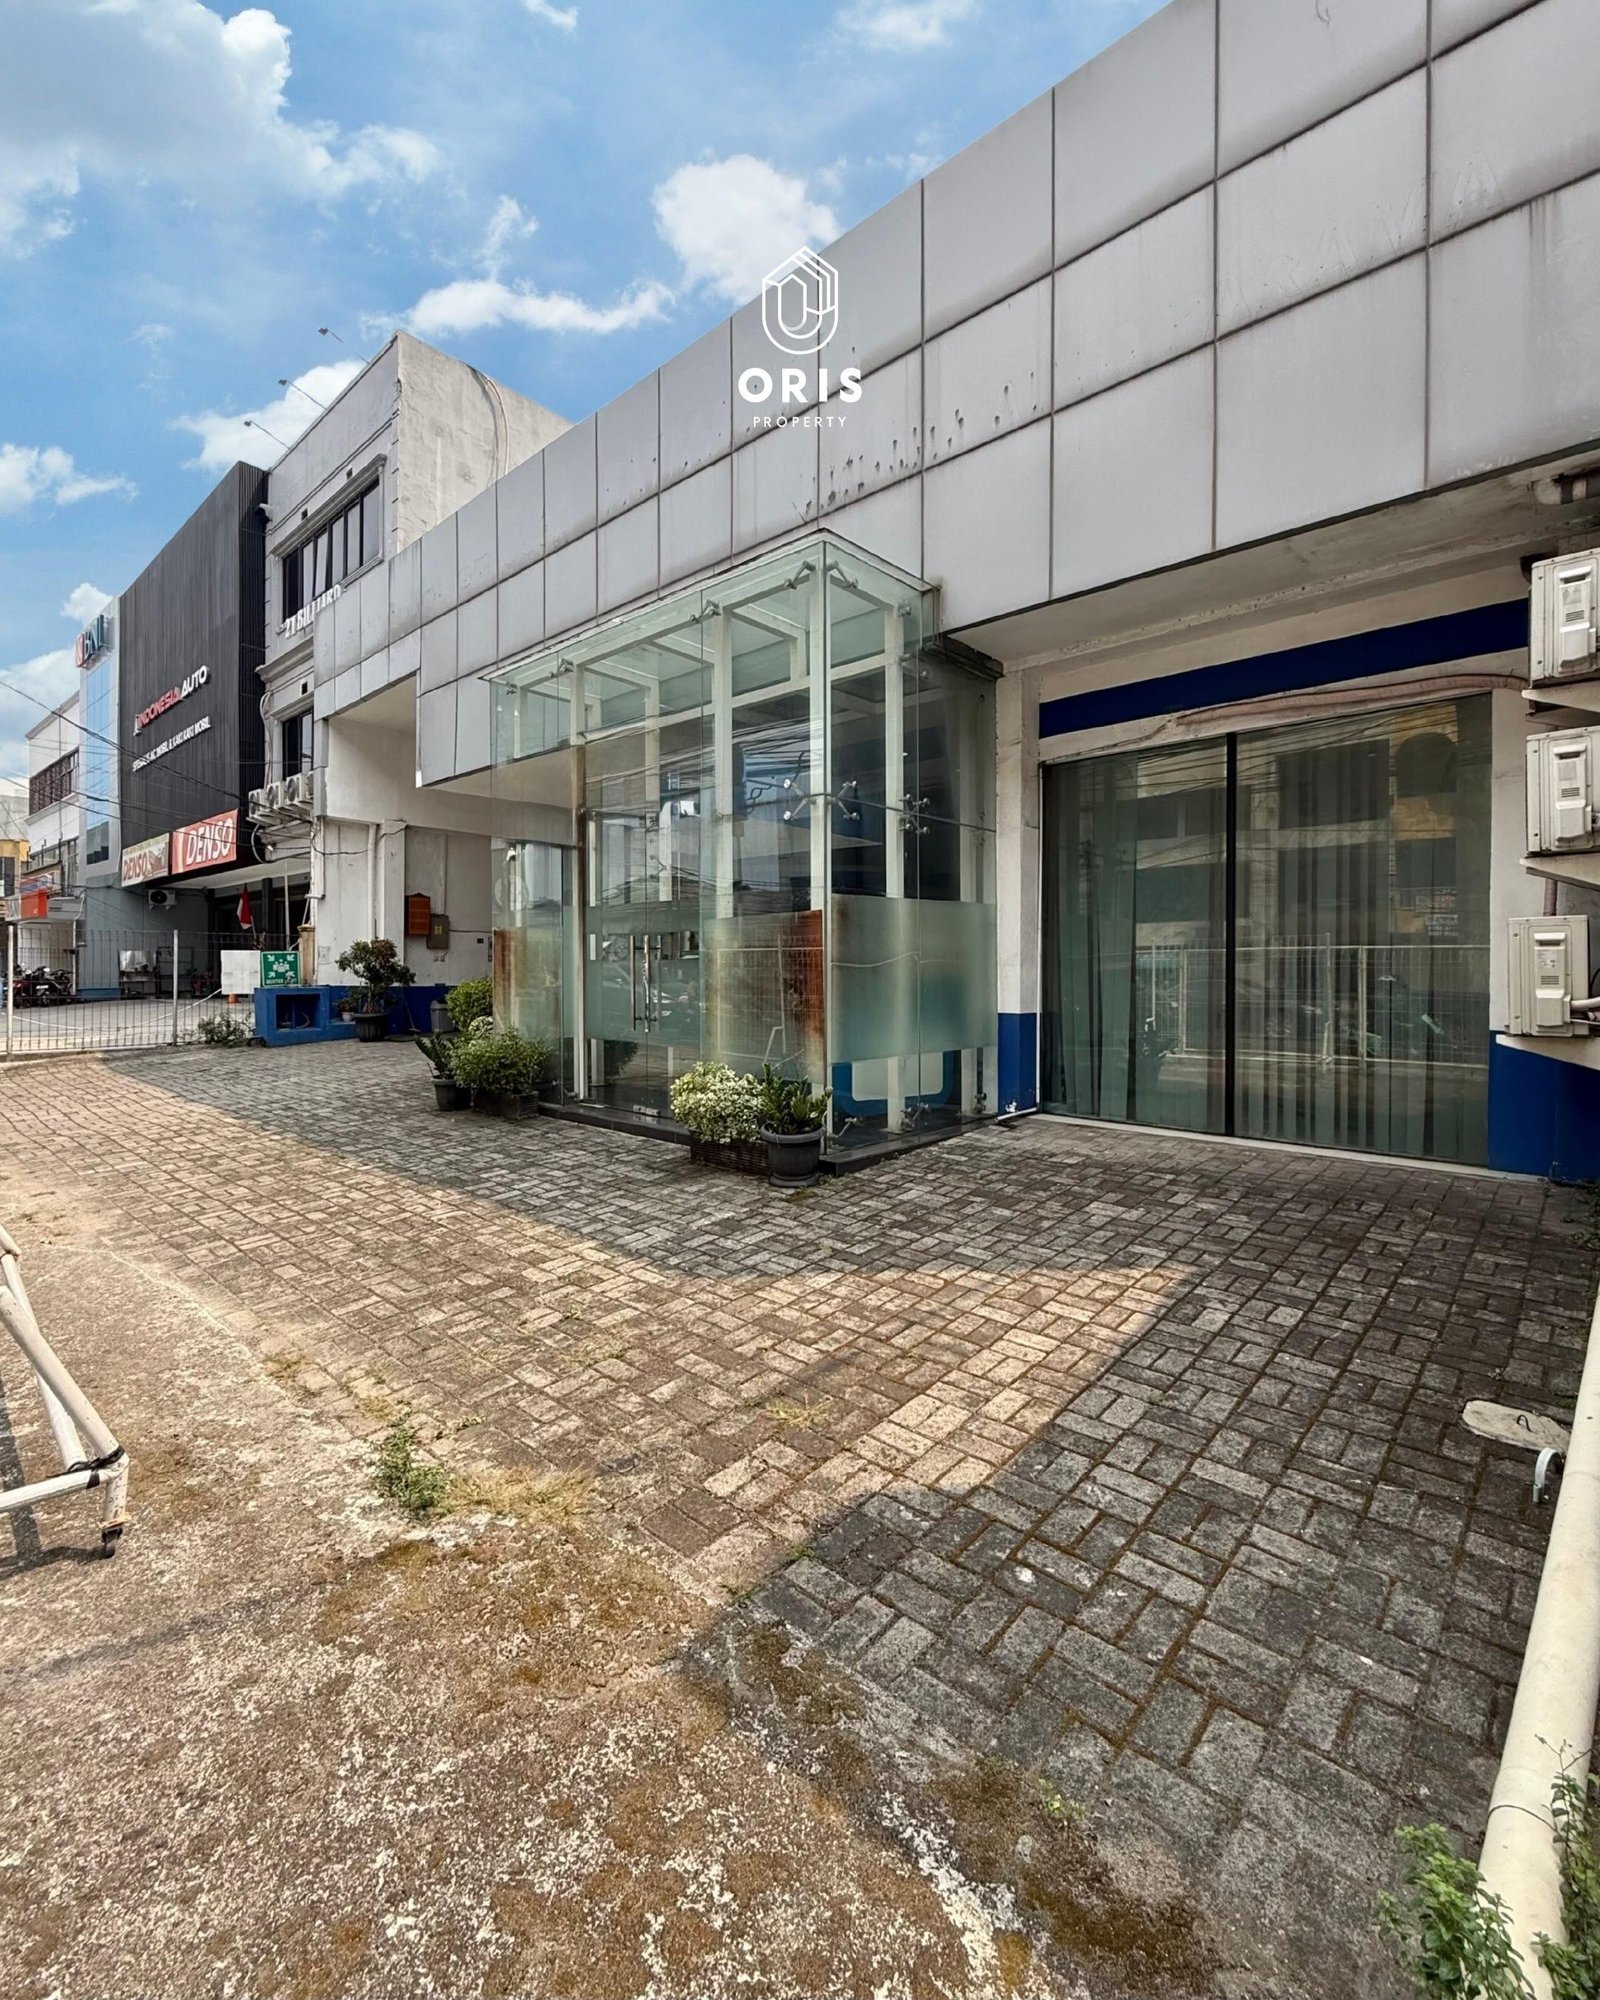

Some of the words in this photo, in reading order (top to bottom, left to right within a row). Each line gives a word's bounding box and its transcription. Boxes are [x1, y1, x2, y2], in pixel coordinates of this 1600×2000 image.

[133, 686, 181, 736] INDONESIA
[181, 665, 208, 698] AUTO
[123, 851, 149, 881] DENSO
[186, 818, 234, 866] DENSO
